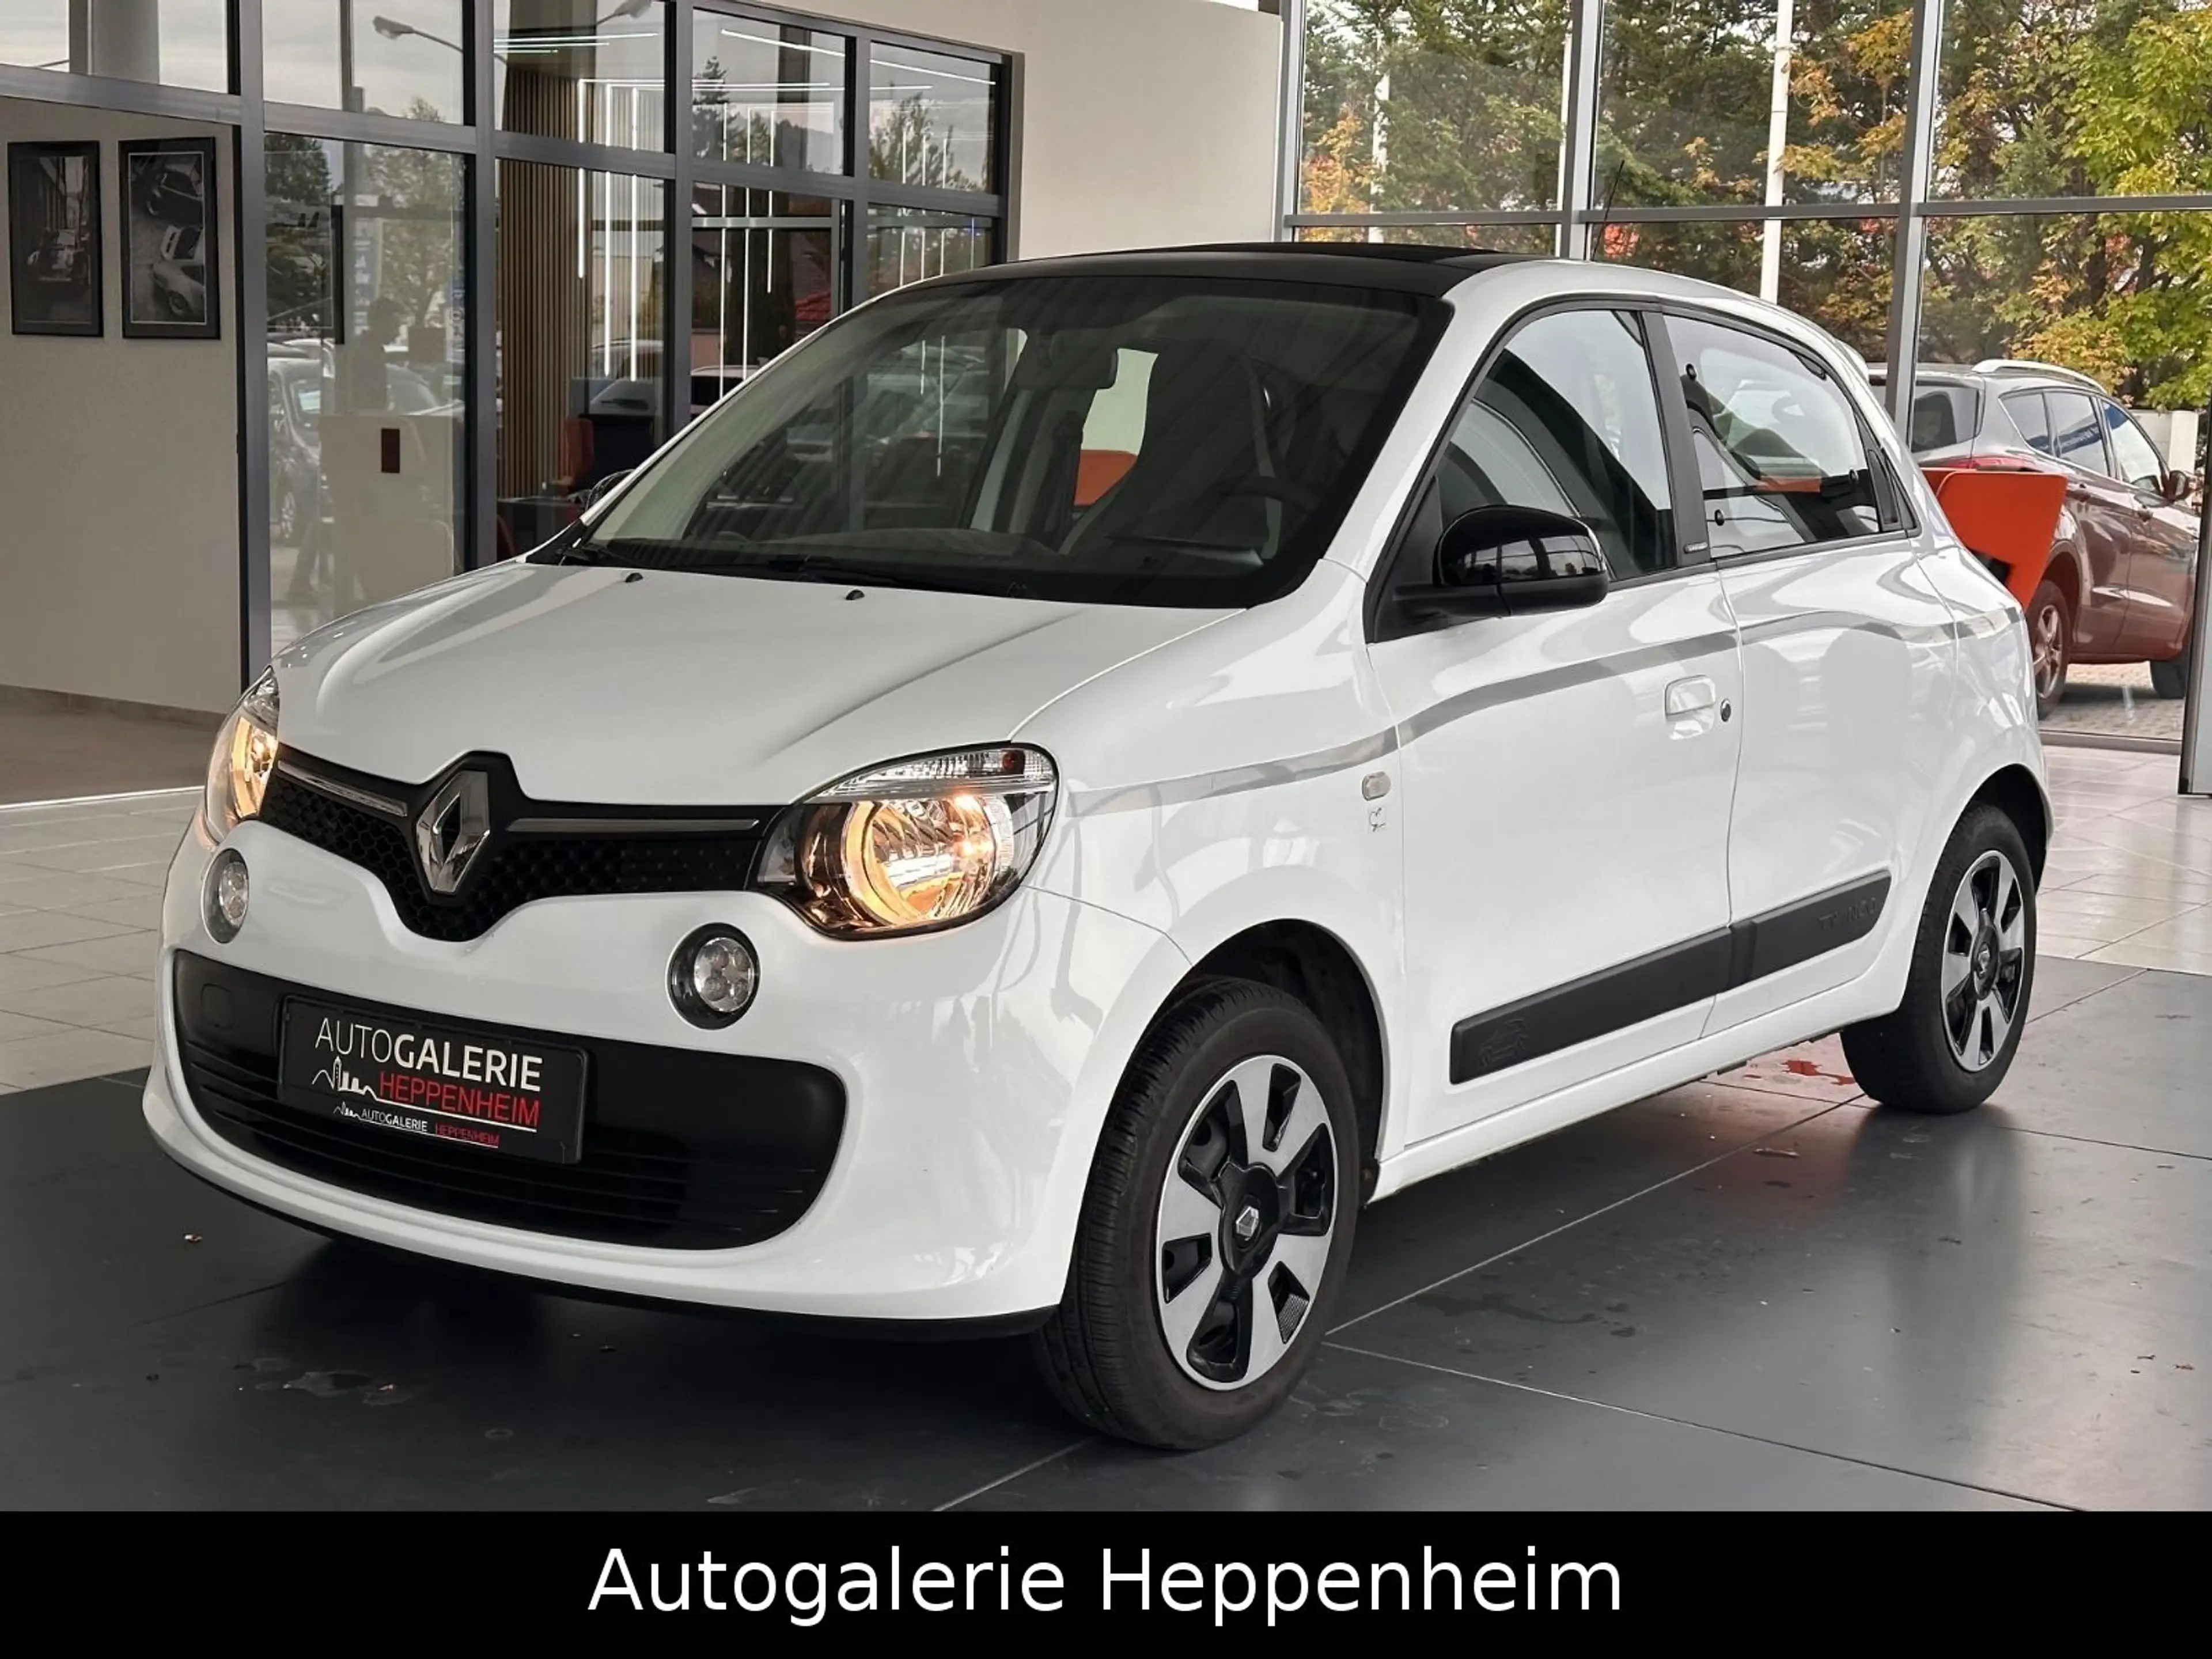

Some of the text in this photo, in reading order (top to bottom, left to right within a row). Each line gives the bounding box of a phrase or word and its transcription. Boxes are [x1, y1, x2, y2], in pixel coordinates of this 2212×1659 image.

[316, 1017, 543, 1092] AUTOGALERIE
[380, 1070, 540, 1126] HEPPENHEIM
[361, 1108, 499, 1146] AUTOGALERIE HEPPENHEIM
